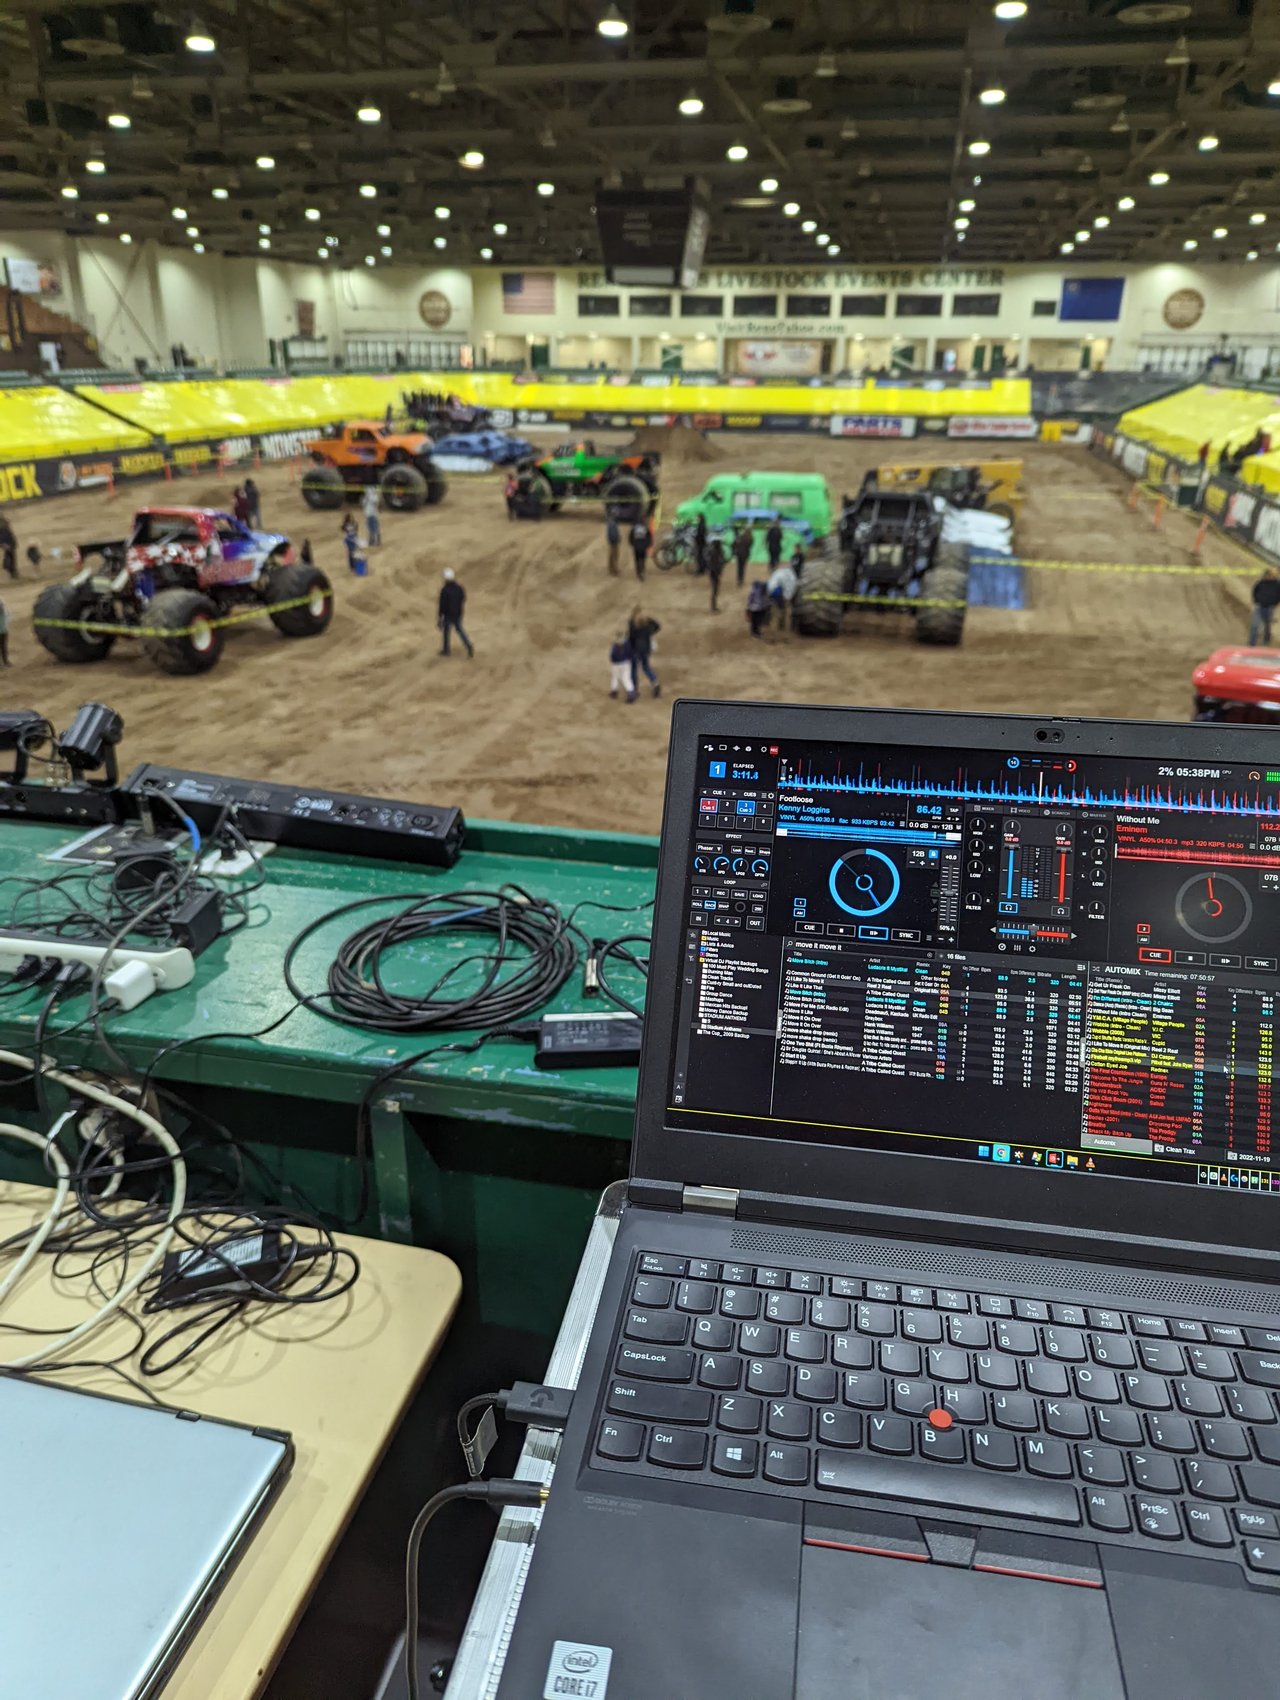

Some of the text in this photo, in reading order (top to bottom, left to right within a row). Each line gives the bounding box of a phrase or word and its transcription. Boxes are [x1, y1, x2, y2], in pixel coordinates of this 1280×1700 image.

[715, 268, 1004, 288] LIVESTOCK EVENTS CENTER
[1158, 767, 1220, 779] 2% 05:38PM
[779, 794, 814, 804] Footloose
[778, 804, 830, 814] Kenny Loggins
[916, 805, 942, 815] 86.42
[1116, 815, 1160, 824] Without Me
[1116, 824, 1148, 834] Eminem
[818, 943, 837, 951] move
[1104, 966, 1141, 976] AUTOMIX
[1159, 972, 1188, 980] remaining:
[1189, 974, 1216, 982] 07:50:57
[1165, 1146, 1195, 1155] Clean Trax
[1239, 1154, 1271, 1162] 2022-11-19
[644, 1256, 659, 1264] Esc
[682, 1295, 688, 1305] 1
[725, 1301, 733, 1311] 2
[769, 1306, 778, 1316] 3
[632, 1314, 648, 1323] Tab
[814, 1312, 824, 1322] 4
[861, 1317, 870, 1328] 5
[1138, 1317, 1162, 1326] Home
[699, 1320, 711, 1332] Q
[744, 1325, 760, 1338] W
[907, 1323, 916, 1334] 6
[1179, 1323, 1196, 1331] End
[1213, 1327, 1237, 1335] Insert
[790, 1332, 800, 1343] E
[953, 1329, 962, 1339] 7
[837, 1337, 848, 1349] R
[1001, 1335, 1010, 1346] 8
[883, 1344, 895, 1355] T
[1049, 1341, 1059, 1353] 9
[623, 1350, 667, 1363] CapsLock
[931, 1350, 943, 1361] Y
[1098, 1348, 1107, 1359] 0
[704, 1358, 716, 1369] A
[979, 1356, 991, 1368] U
[751, 1363, 763, 1375] S
[800, 1369, 811, 1381] D
[848, 1375, 858, 1386] F
[1078, 1370, 1092, 1382] O
[1128, 1376, 1139, 1387] P
[614, 1386, 636, 1397] Shift
[897, 1383, 910, 1395] G
[947, 1390, 959, 1402] H
[722, 1398, 735, 1410] Z
[997, 1397, 1006, 1409] J
[772, 1405, 785, 1417] X
[1047, 1403, 1061, 1415] K
[822, 1411, 835, 1424] C
[1099, 1410, 1111, 1422] L
[873, 1418, 886, 1430] V
[605, 1427, 617, 1437] Fn
[924, 1431, 936, 1442] B
[655, 1433, 673, 1444] Ctrl
[975, 1433, 989, 1445] N
[1028, 1441, 1044, 1454] M
[769, 1450, 784, 1460] Alt
[1091, 1496, 1105, 1506] Alt
[1140, 1502, 1169, 1516] PrtSc
[1190, 1510, 1210, 1521] Ctrl
[1239, 1513, 1265, 1525] PgUp
[567, 1656, 593, 1667] intel
[554, 1675, 598, 1697] CORE i7
